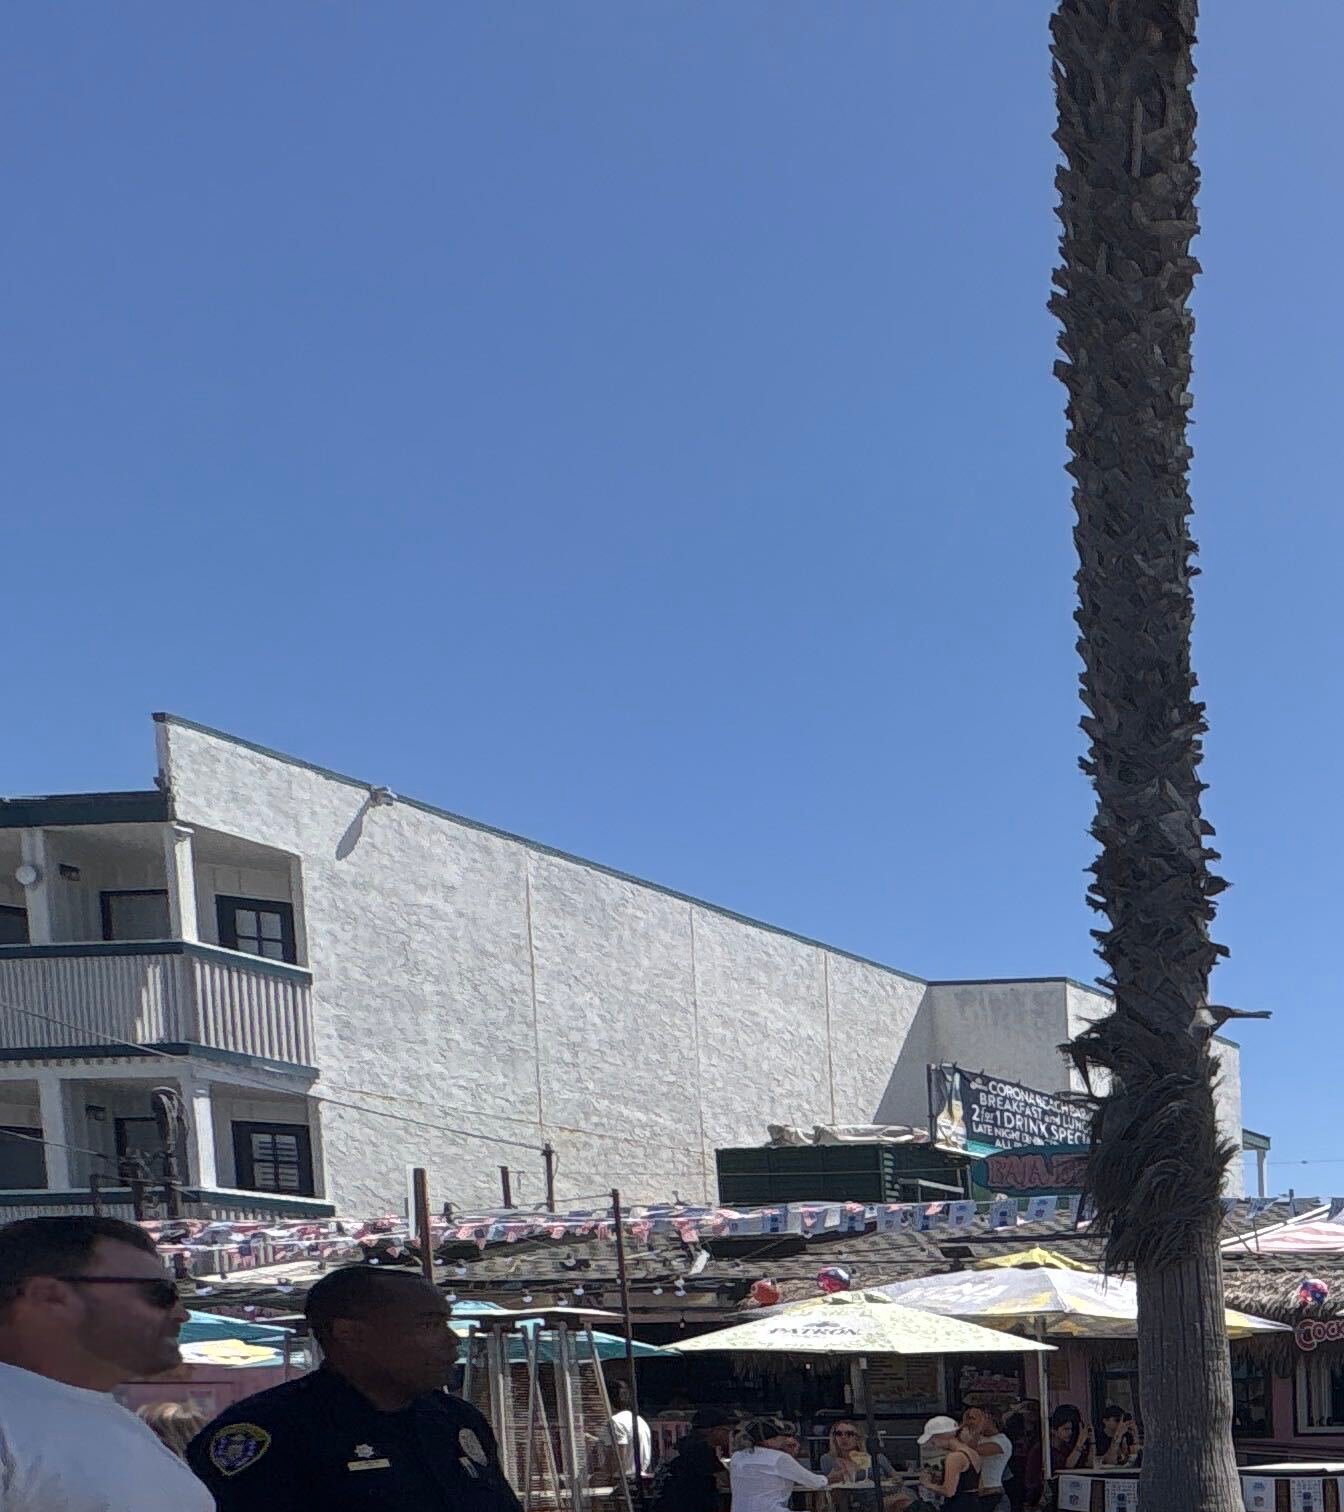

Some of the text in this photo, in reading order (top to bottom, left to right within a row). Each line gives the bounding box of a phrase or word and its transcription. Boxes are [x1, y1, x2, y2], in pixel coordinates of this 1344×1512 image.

[971, 1104, 980, 1122] 2
[1003, 1111, 1050, 1138] DRINK
[979, 1092, 1043, 1120] BREAKFAST
